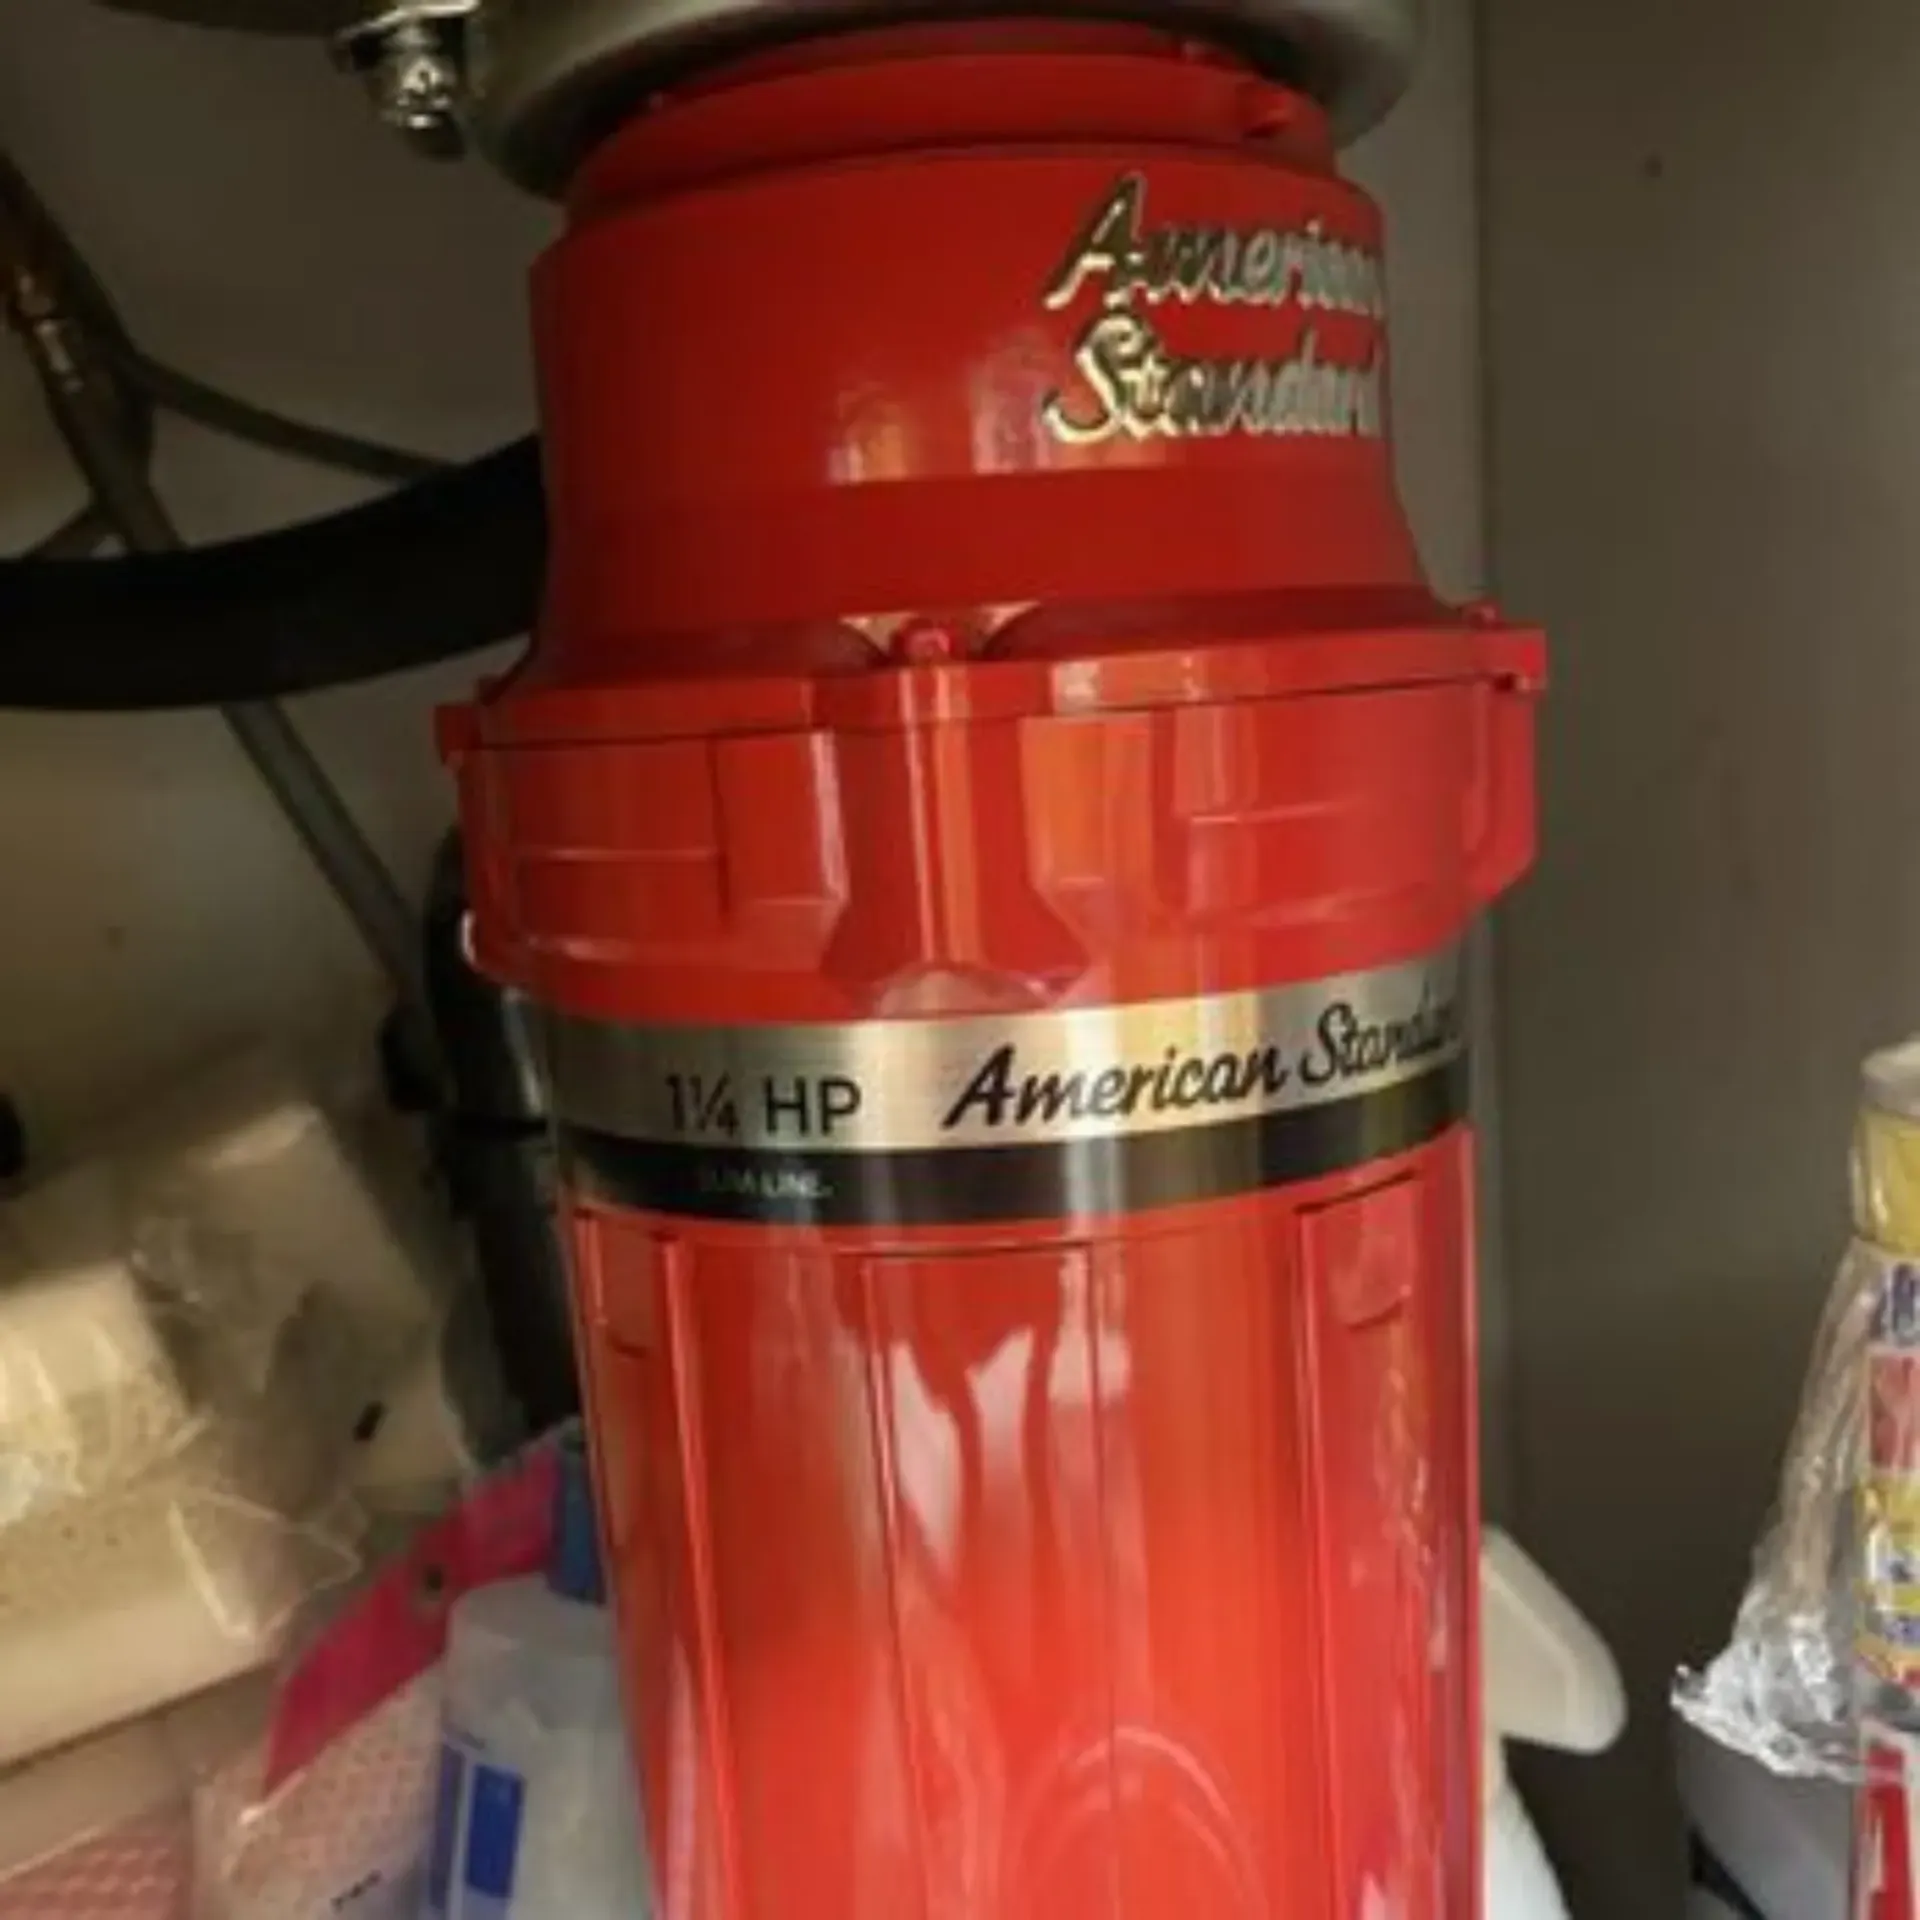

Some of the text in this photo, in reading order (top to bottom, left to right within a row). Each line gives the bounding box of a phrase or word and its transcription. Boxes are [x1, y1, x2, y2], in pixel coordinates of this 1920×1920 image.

[763, 1073, 862, 1136] HP
[939, 980, 1461, 1131] American Standa
